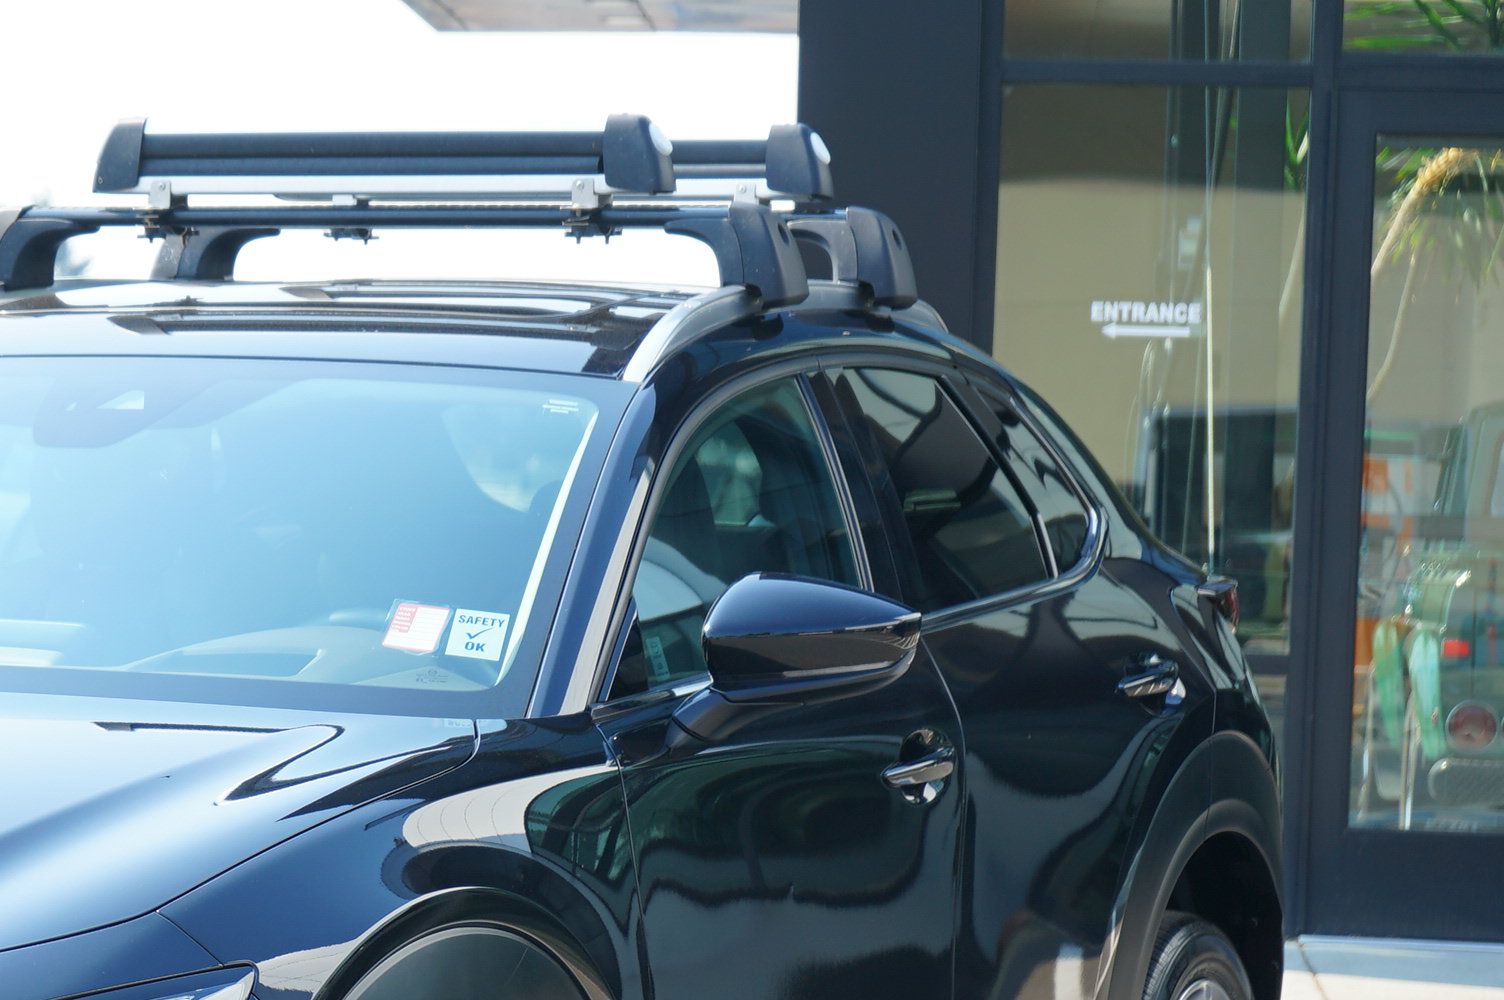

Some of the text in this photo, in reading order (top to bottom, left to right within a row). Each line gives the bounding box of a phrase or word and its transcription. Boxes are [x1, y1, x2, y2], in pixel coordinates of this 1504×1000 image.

[1090, 300, 1201, 324] ENTRANCE
[458, 614, 505, 628] SAFETY
[464, 641, 486, 653] OK
